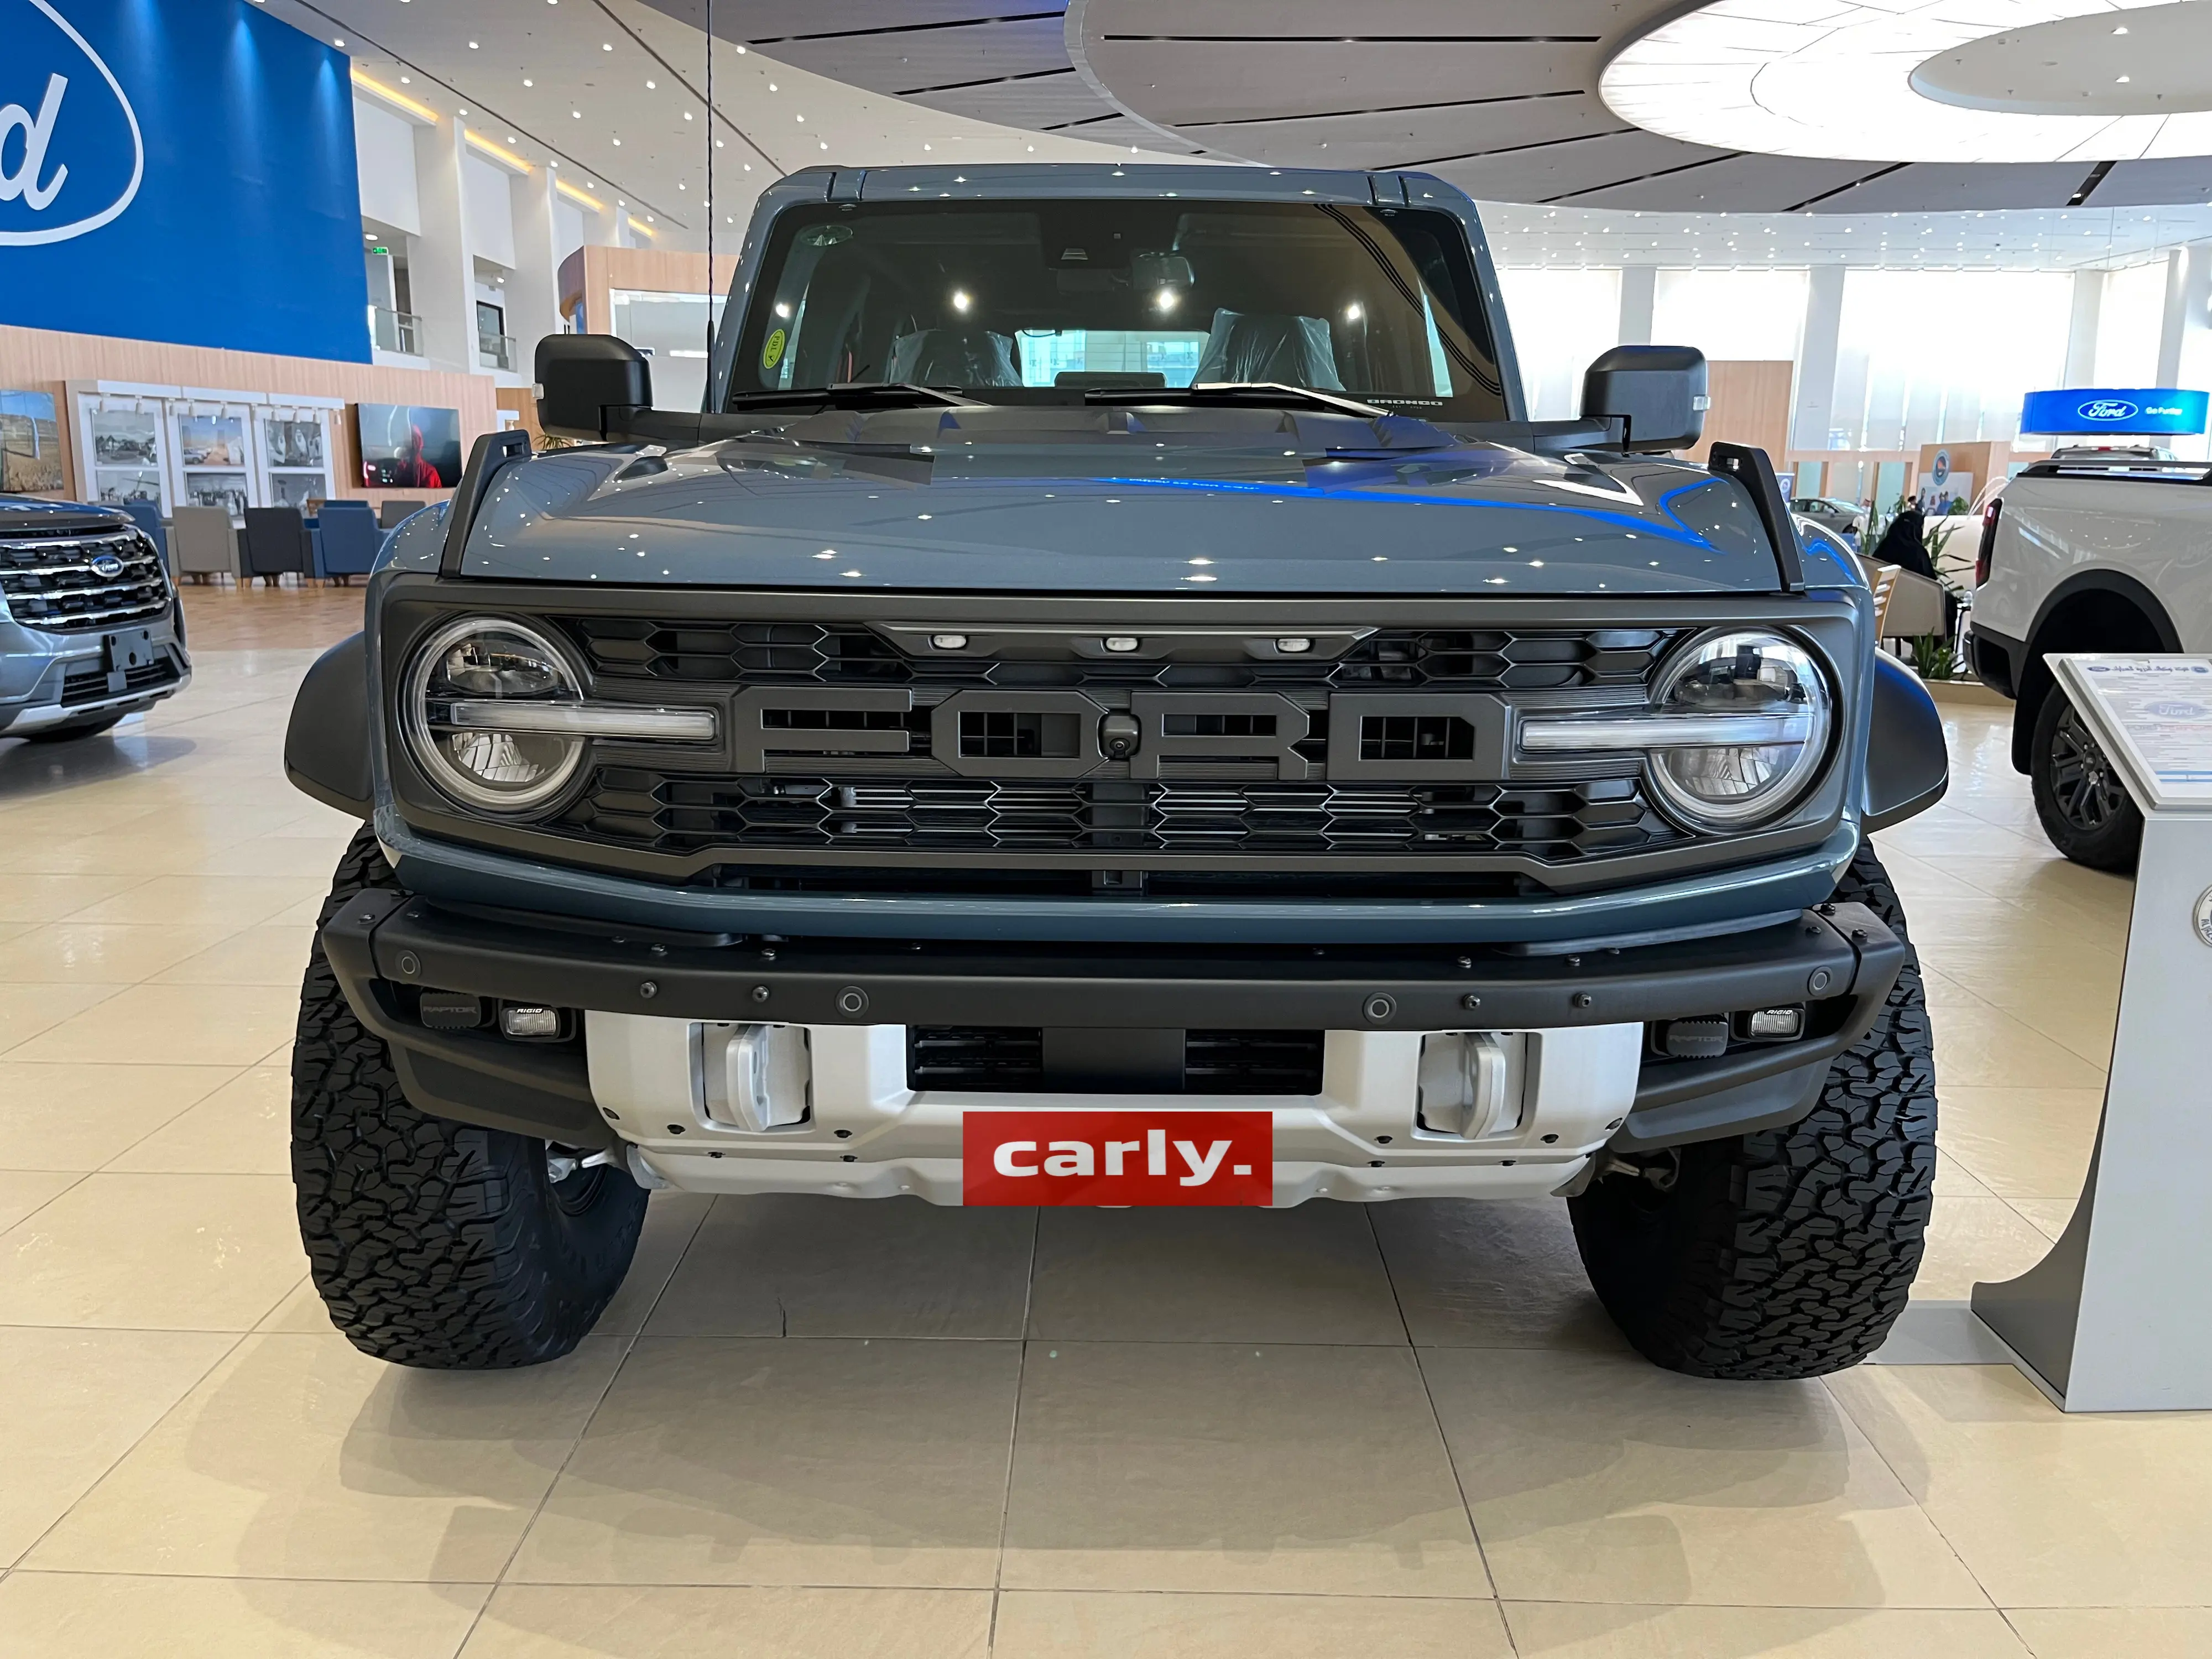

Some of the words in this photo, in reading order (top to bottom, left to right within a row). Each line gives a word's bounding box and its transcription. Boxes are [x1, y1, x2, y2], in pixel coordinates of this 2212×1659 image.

[2089, 403, 2127, 416] Ford
[2159, 704, 2195, 715] Ford
[733, 686, 1506, 780] FORD
[423, 1005, 478, 1014] RAPTOR
